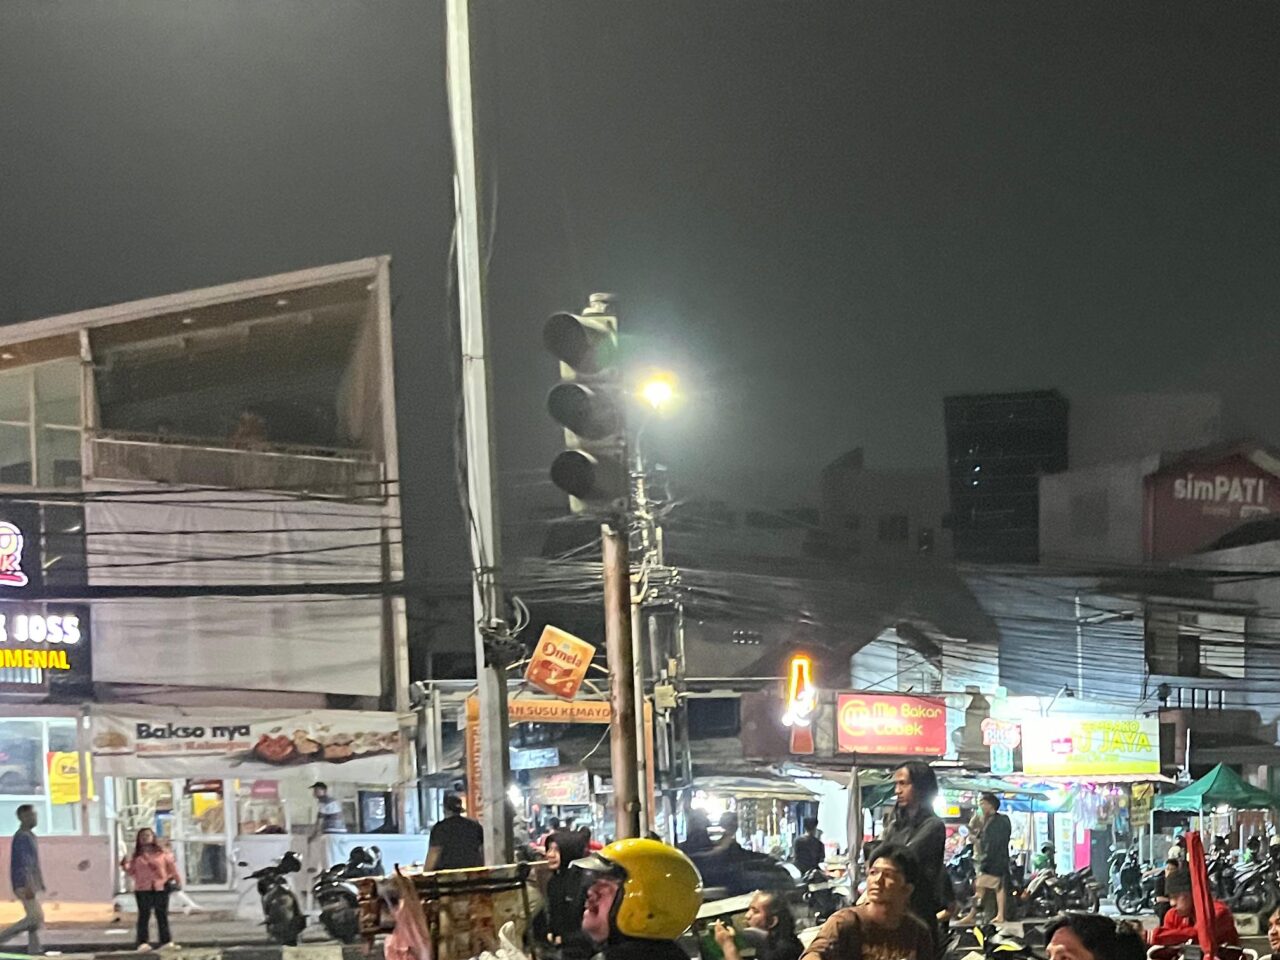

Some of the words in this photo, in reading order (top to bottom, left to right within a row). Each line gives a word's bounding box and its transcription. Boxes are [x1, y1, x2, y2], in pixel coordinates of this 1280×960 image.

[1174, 473, 1264, 503] simPATI
[13, 614, 81, 645] JOSS
[0, 649, 70, 669] MENAL
[542, 642, 583, 667] Omela
[526, 706, 558, 716] SUSU
[561, 708, 612, 717] KEMAYO
[901, 703, 942, 719] Bakar
[136, 722, 205, 739] Bakso
[212, 724, 250, 740] nya
[1098, 731, 1152, 753] JAYA
